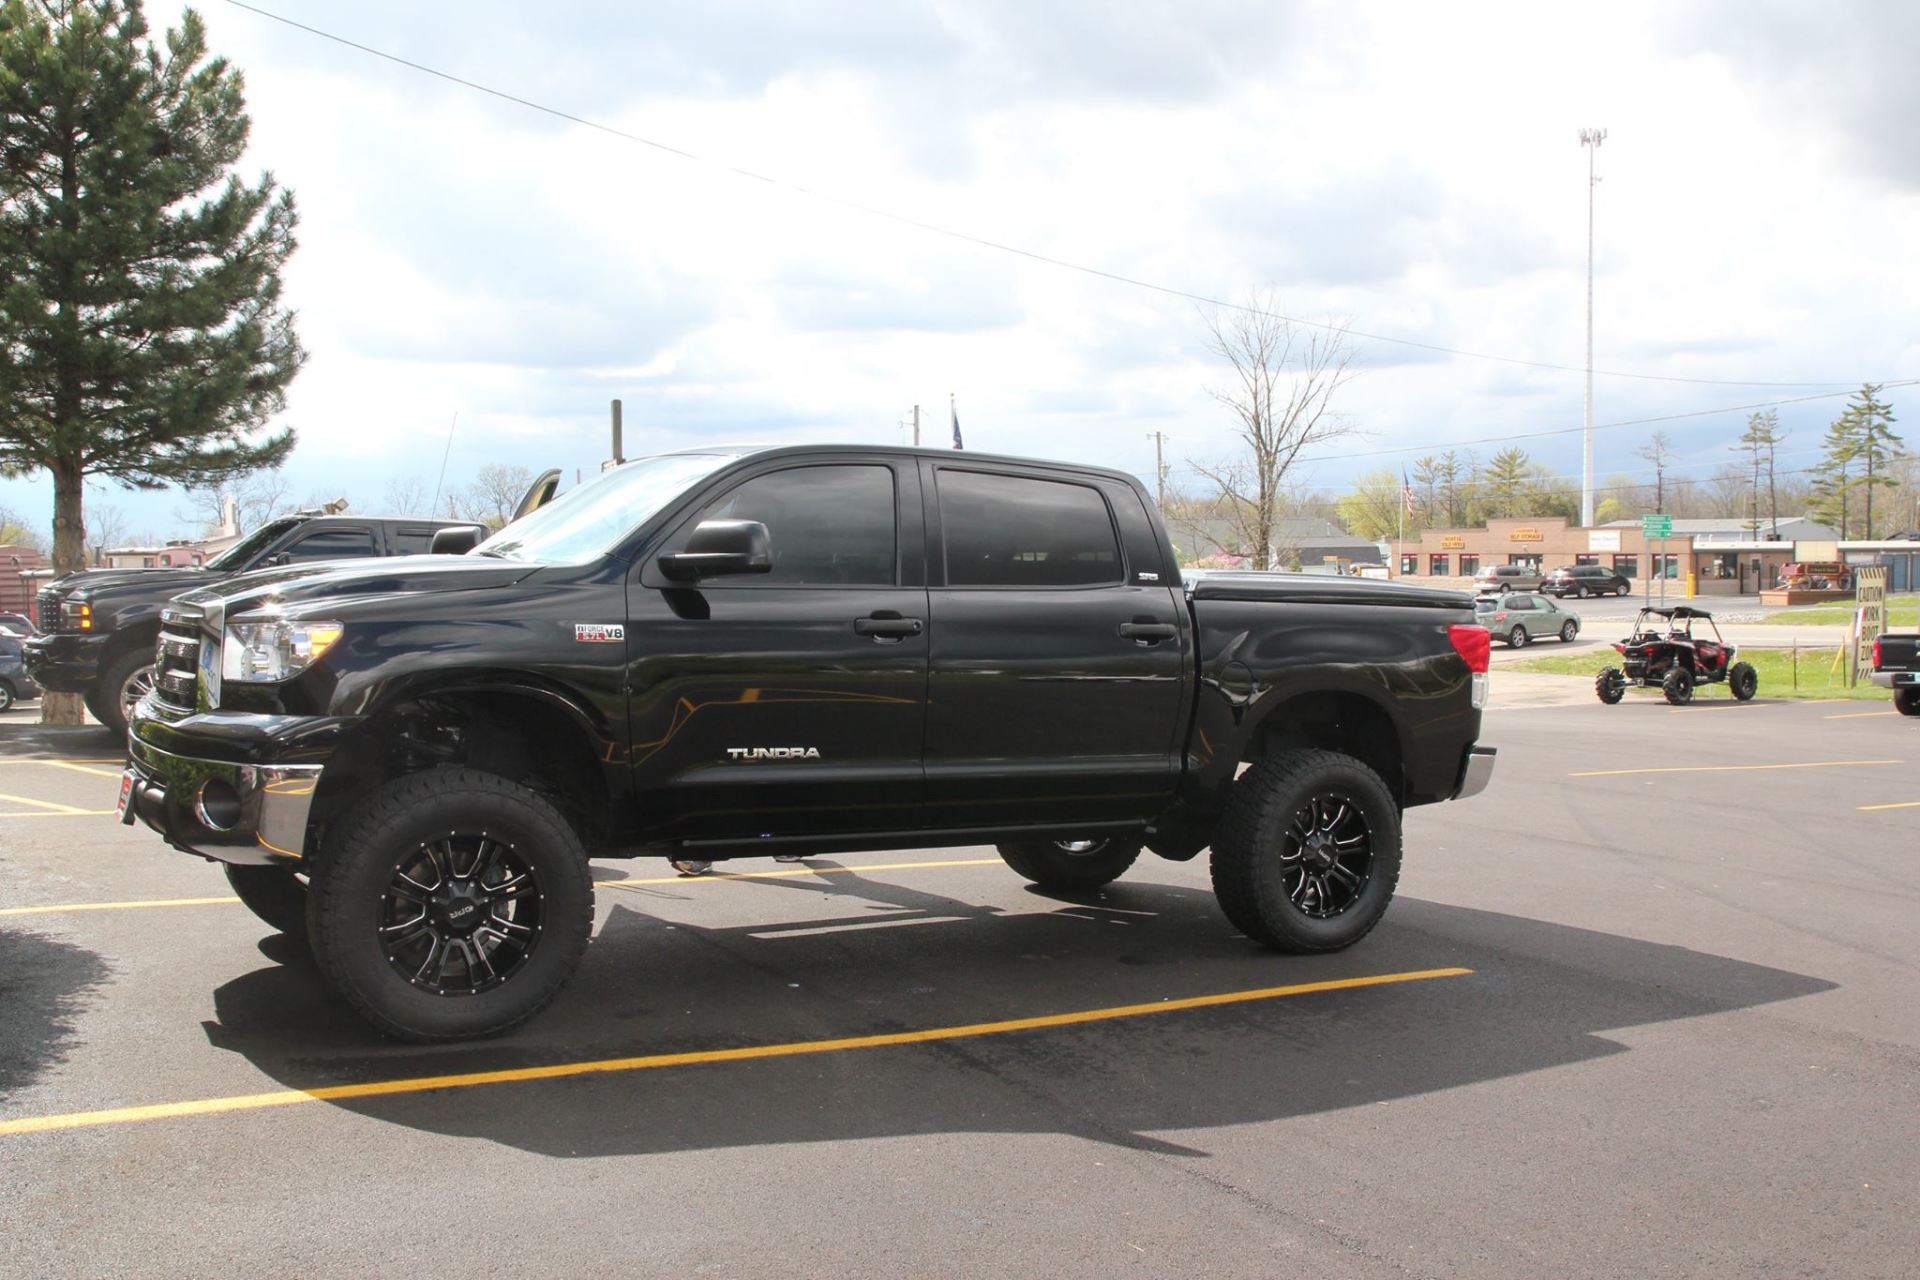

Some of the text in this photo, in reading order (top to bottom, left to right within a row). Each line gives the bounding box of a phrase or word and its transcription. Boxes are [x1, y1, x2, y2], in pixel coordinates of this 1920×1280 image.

[1859, 587, 1882, 602] CAUTION
[605, 628, 623, 639] V8
[1862, 625, 1879, 641] BOOT
[1861, 645, 1873, 661] ZON
[727, 746, 821, 759] TUNDRA
